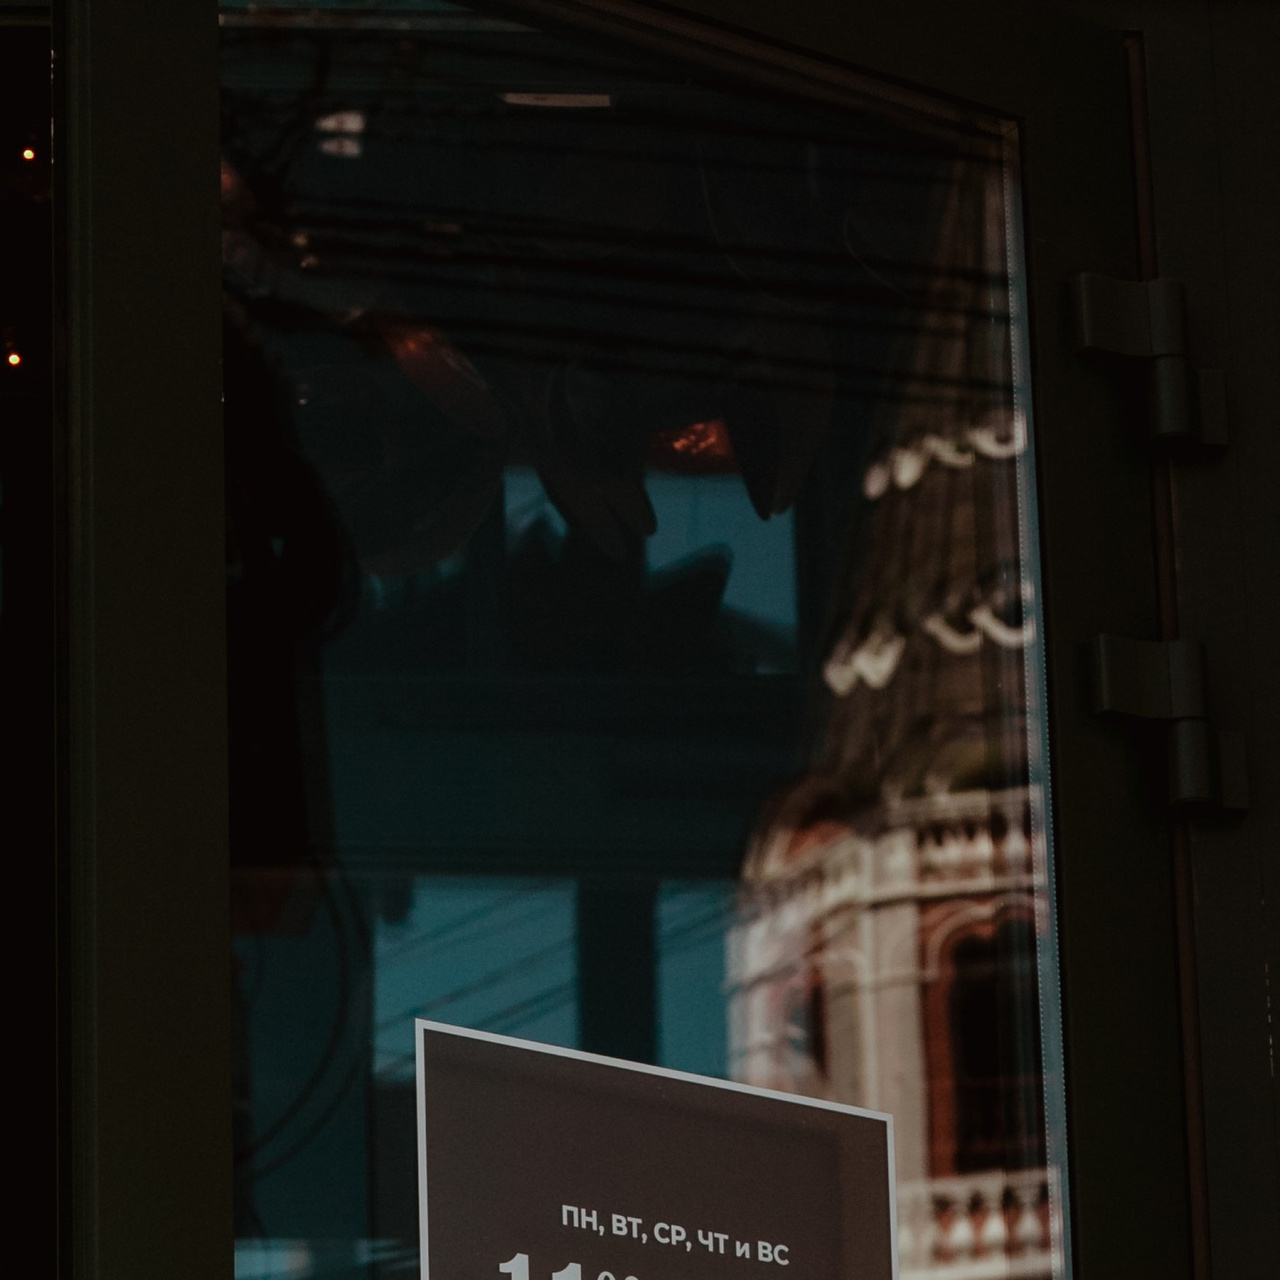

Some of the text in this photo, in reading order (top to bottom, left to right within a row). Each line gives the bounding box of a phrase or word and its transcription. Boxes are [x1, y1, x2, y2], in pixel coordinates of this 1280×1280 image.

[561, 1204, 790, 1266] ПН, ВТ, СР, ЧТ и ВС
